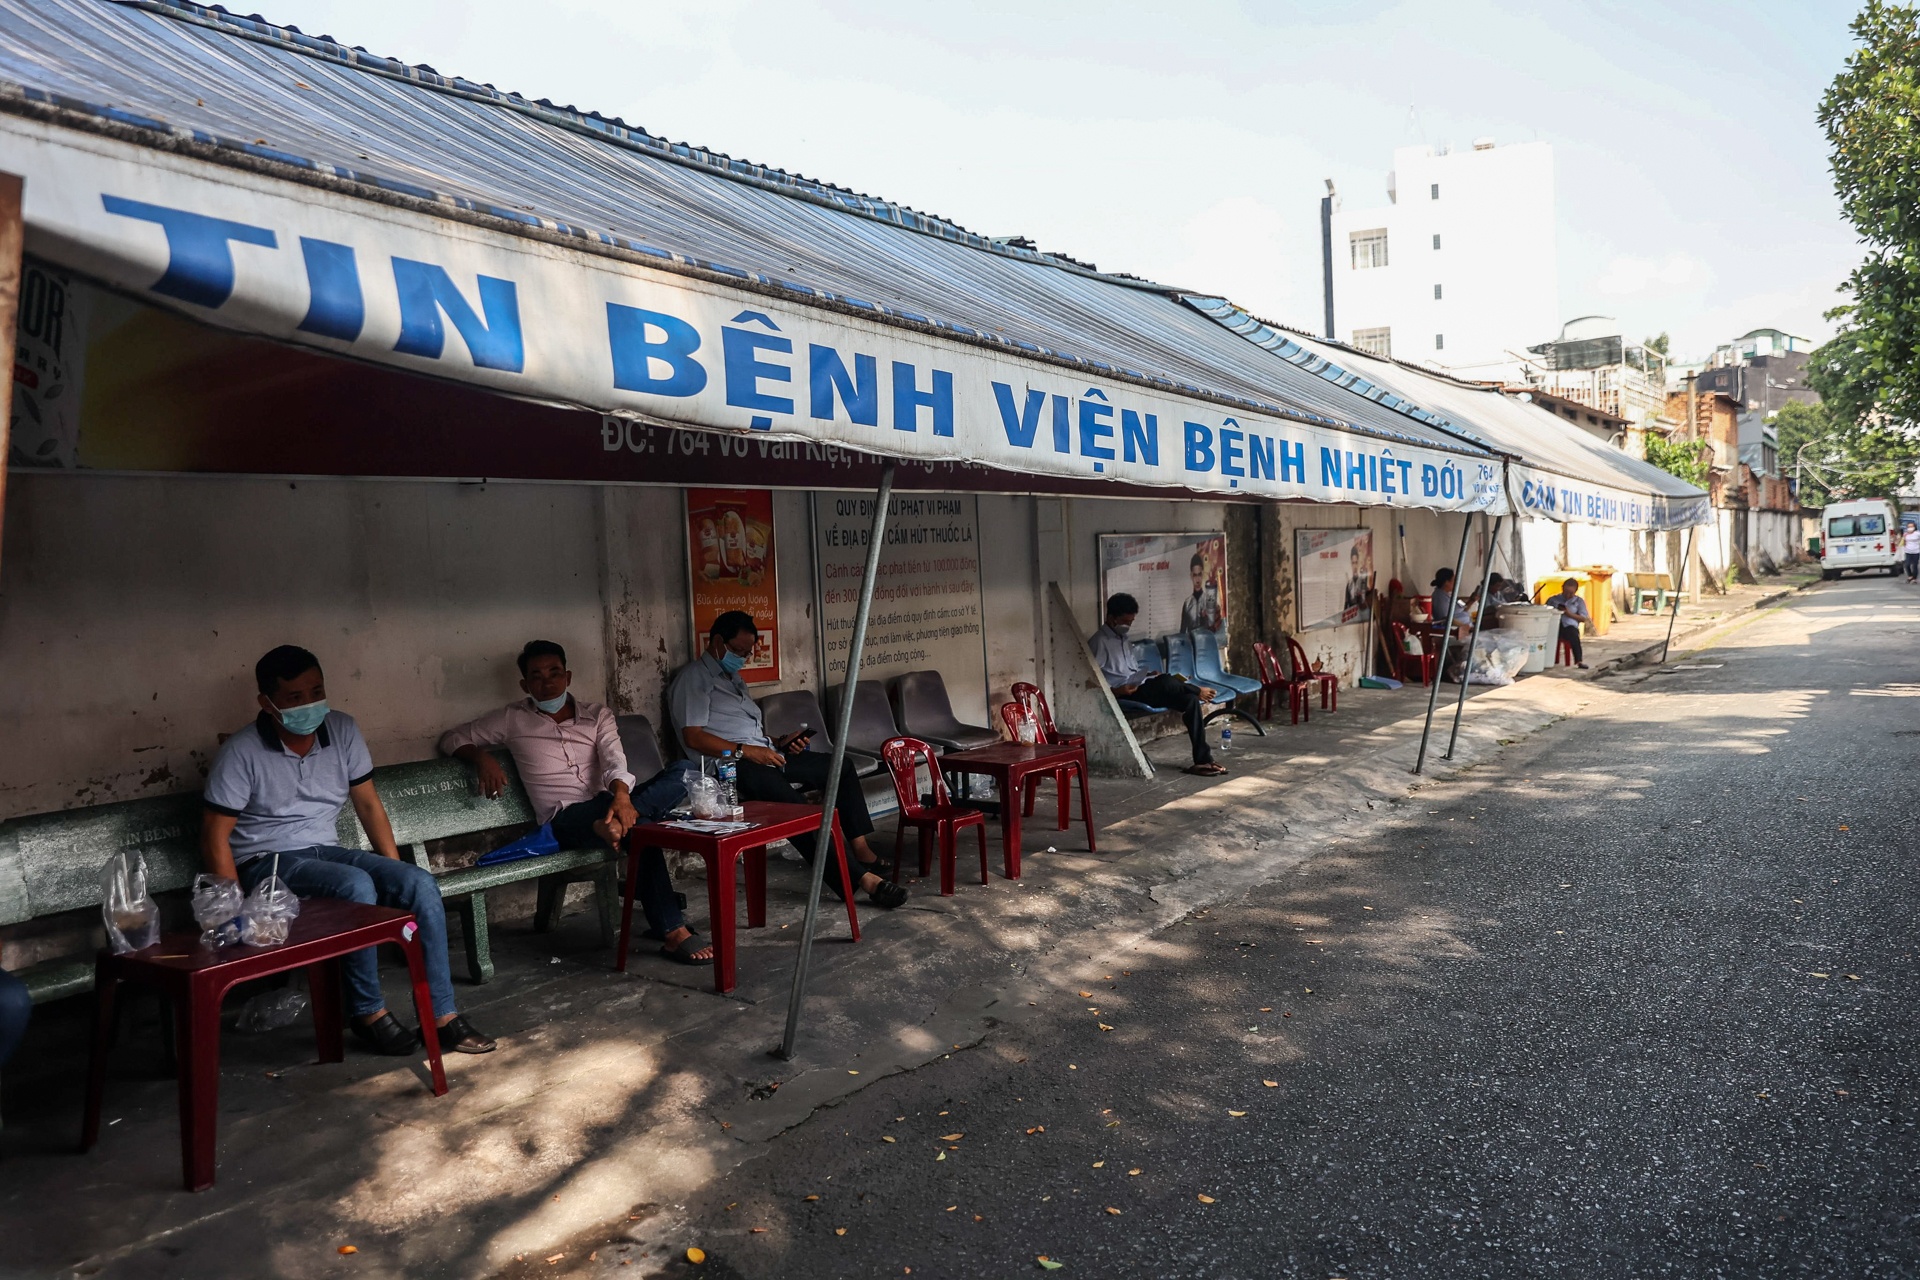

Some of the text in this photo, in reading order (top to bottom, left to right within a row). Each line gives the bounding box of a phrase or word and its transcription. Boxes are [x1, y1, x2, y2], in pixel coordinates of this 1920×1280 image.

[101, 193, 1465, 501] TIN BỆNH VIỆN BỆNH NHIỆT ĐỚI
[1477, 464, 1494, 481] 764
[837, 499, 857, 516] QUY
[860, 500, 876, 519] ĐỊN
[901, 500, 924, 518] PHẠT
[927, 500, 935, 515] VI
[938, 500, 961, 518] PHẠM
[1522, 479, 1556, 511] CĂN
[1561, 489, 1582, 516] TIN
[825, 523, 839, 546] VỀ
[842, 529, 859, 550] ĐỊA
[888, 522, 908, 545] CẤM
[911, 524, 928, 544] HÚT
[931, 521, 960, 543] THUỐC
[962, 523, 973, 542] LÁ
[826, 563, 849, 579] Cảnh
[890, 562, 907, 579] phạt
[908, 559, 922, 575] tiền
[934, 559, 959, 573] 100.000
[960, 557, 977, 574] đồng
[825, 588, 841, 604] đến
[875, 586, 895, 602] đồng
[896, 584, 909, 599] đối
[910, 583, 922, 597] với
[924, 582, 942, 596] hành
[942, 582, 948, 594] vi
[949, 583, 960, 594] sau
[827, 617, 840, 631] Hút
[841, 616, 856, 630] thuố
[877, 614, 887, 629] địa
[888, 611, 903, 626] điểm
[904, 613, 911, 623] có
[912, 612, 922, 625] quy
[923, 609, 936, 624] định
[966, 604, 970, 616] Y
[828, 640, 837, 651] cơ
[839, 638, 848, 650] sở
[880, 633, 890, 645] nơi
[891, 632, 902, 645] làm
[916, 628, 939, 645] phương
[939, 627, 950, 640] tiện
[951, 625, 964, 638] giao
[964, 622, 979, 636] thông
[829, 658, 846, 673] công
[866, 656, 876, 669] địa
[877, 652, 893, 667] điểm
[893, 652, 909, 665] công
